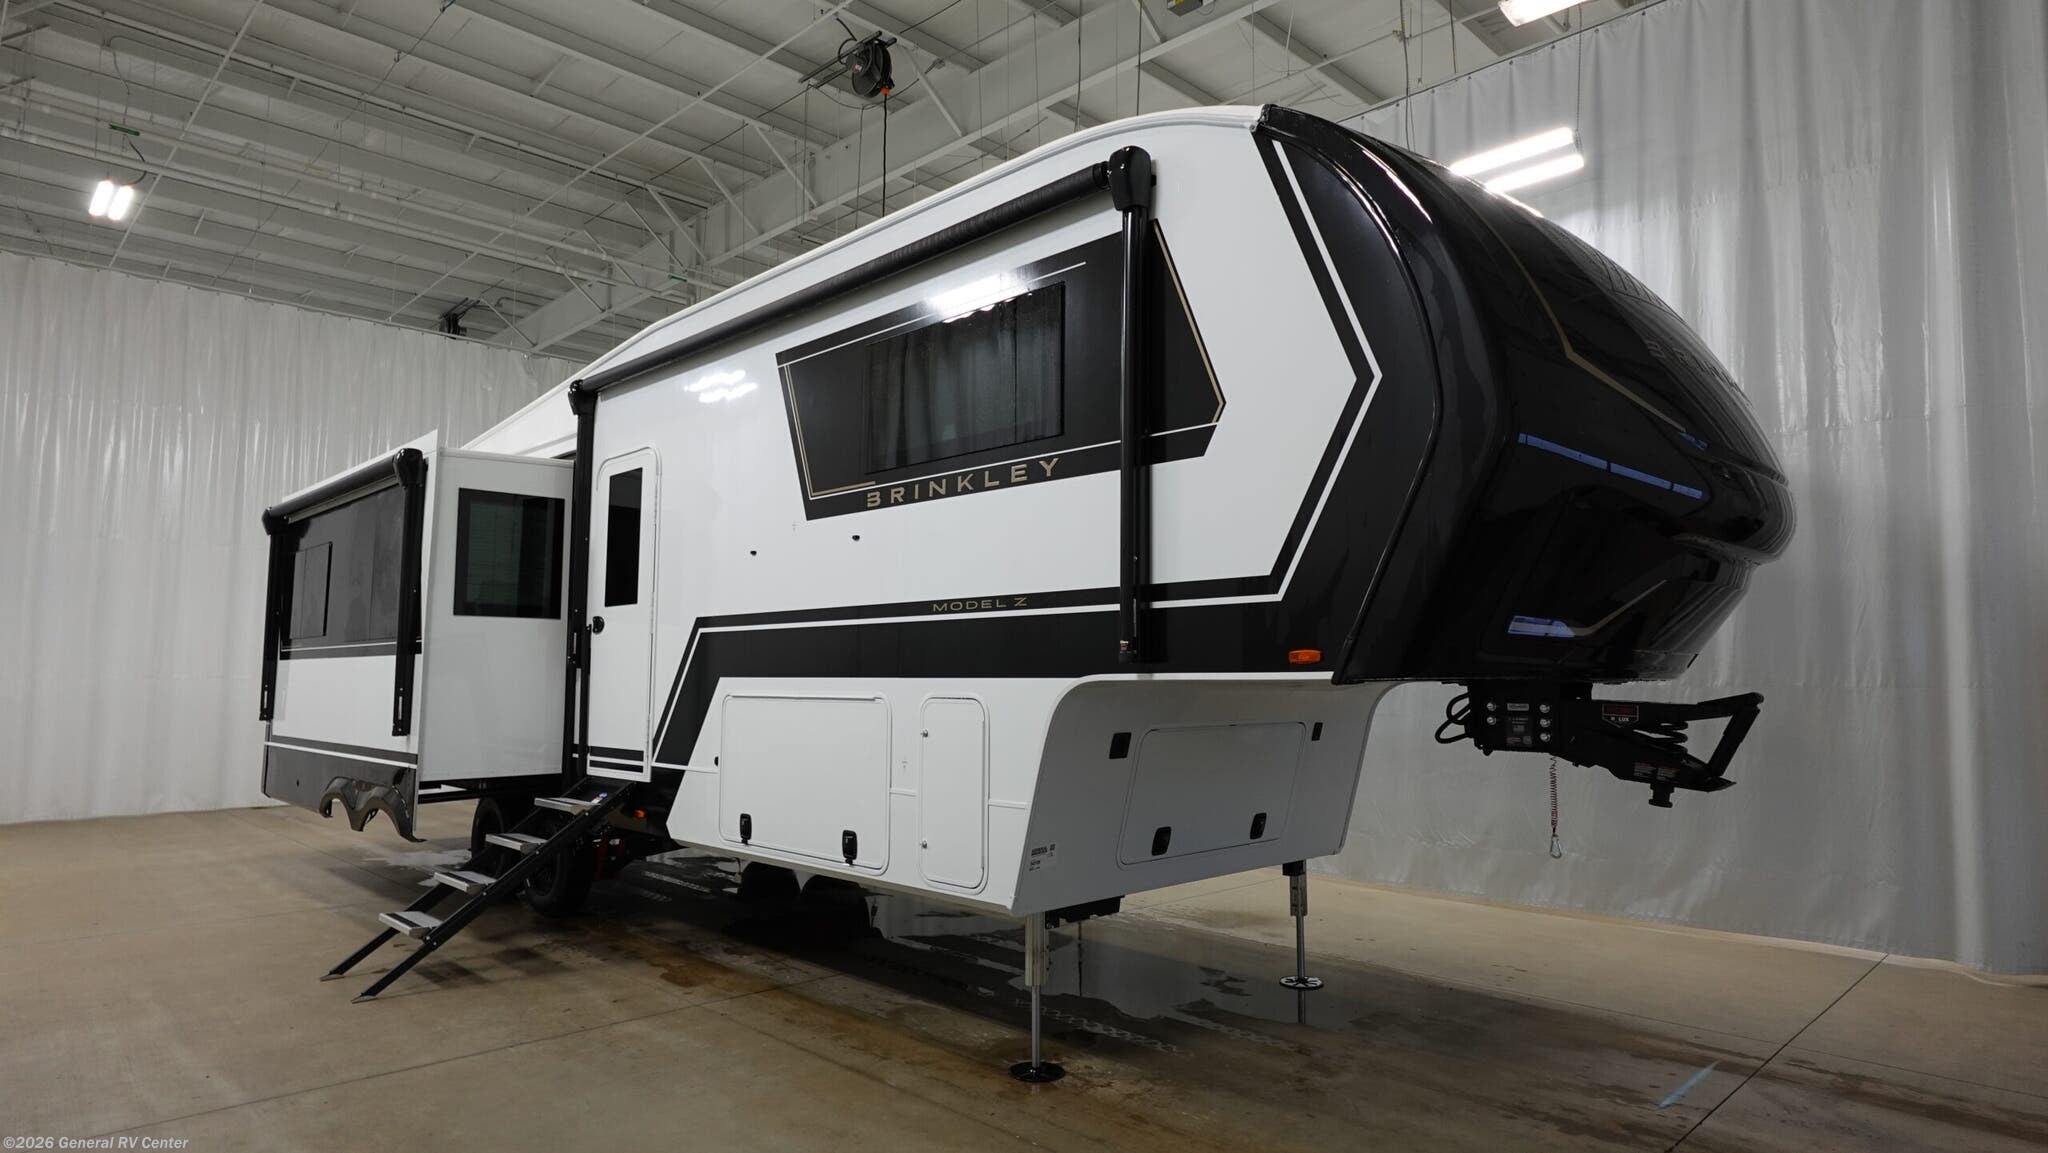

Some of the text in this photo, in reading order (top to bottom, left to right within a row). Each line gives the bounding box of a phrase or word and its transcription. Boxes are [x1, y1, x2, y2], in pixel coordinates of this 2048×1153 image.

[867, 457, 1059, 508] BRINKLEY
[933, 597, 1028, 612] MODEL Z
